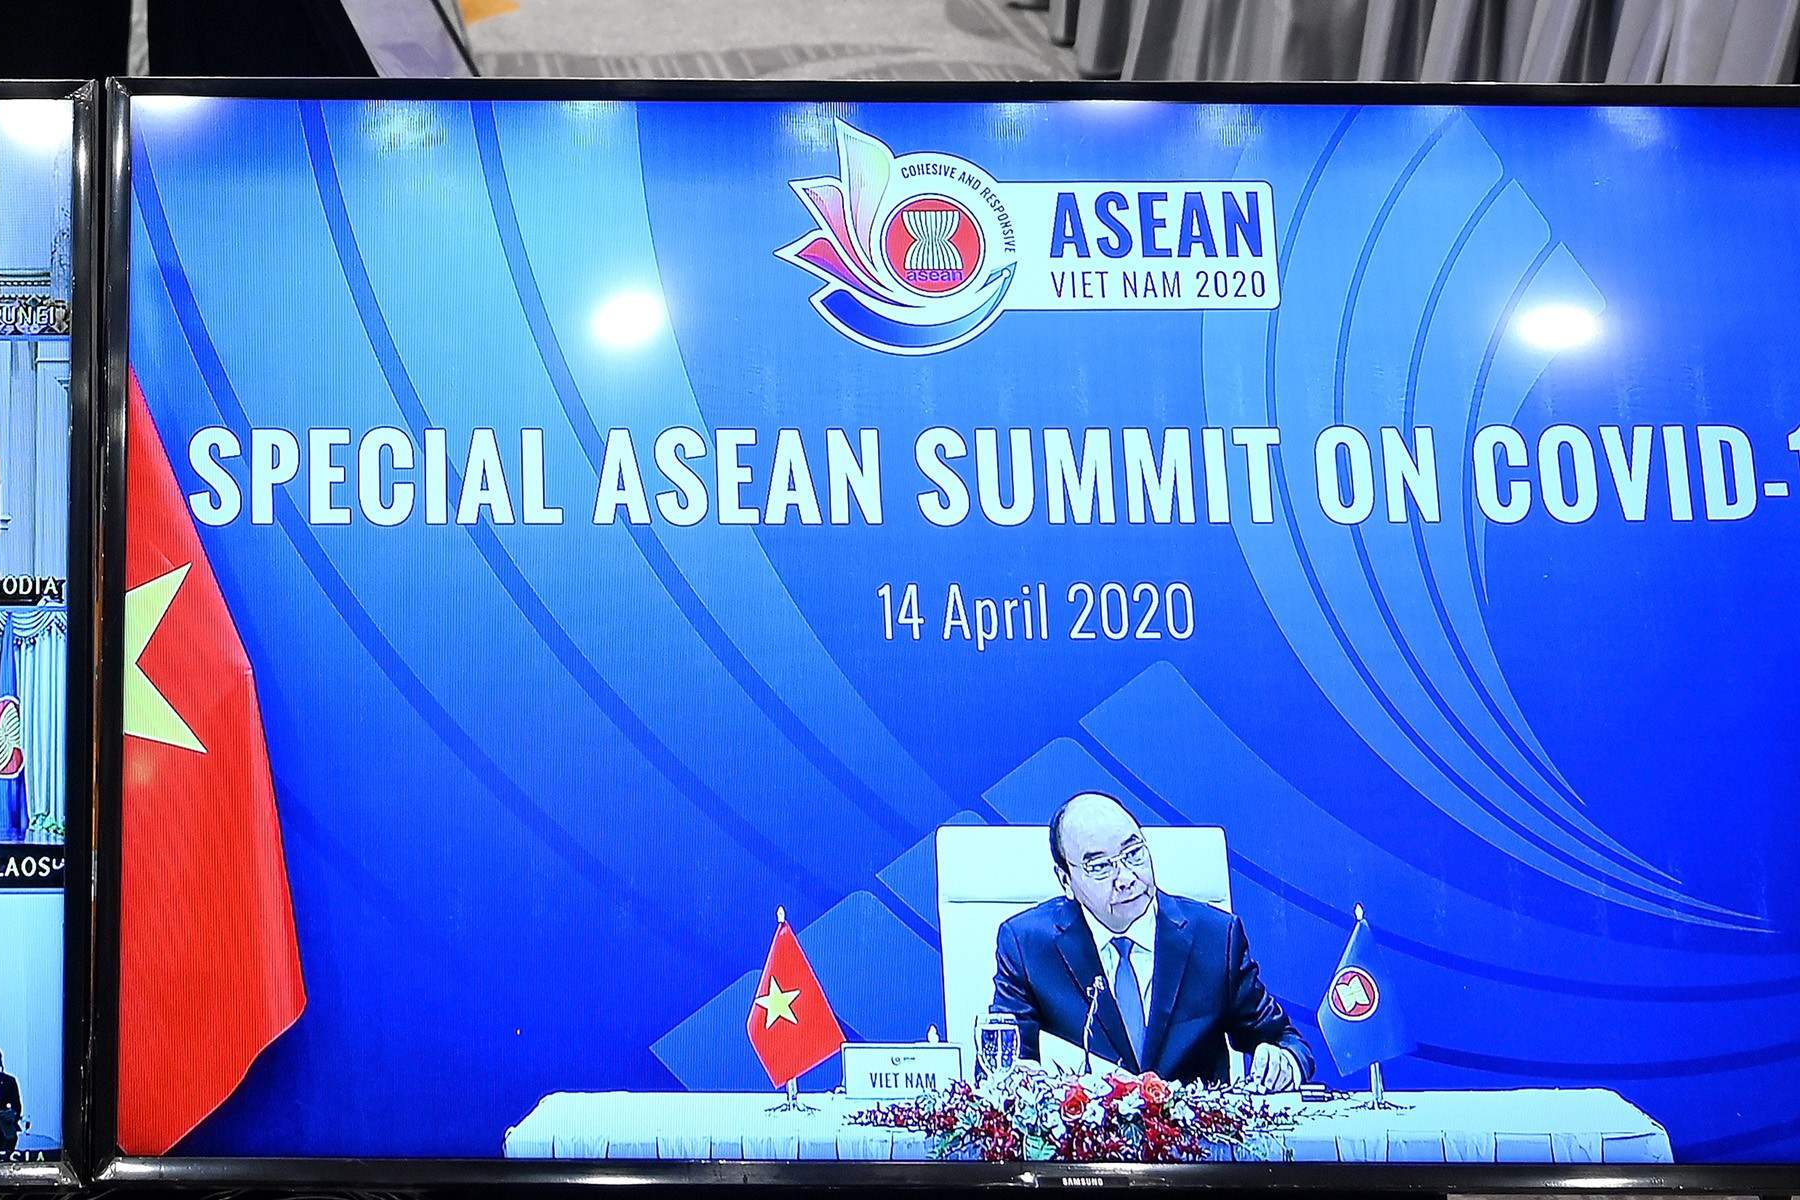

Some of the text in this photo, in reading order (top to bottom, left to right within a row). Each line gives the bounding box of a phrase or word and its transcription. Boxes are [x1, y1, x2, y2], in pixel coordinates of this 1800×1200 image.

[901, 163, 1016, 253] COHESIVE AND RESPONSIVE
[1049, 189, 1265, 259] ASEAN
[906, 270, 964, 281] asean
[1050, 270, 1267, 299] VIET NAM 2020
[188, 426, 564, 527] SPECIAL
[591, 426, 883, 527] ASEAN
[914, 425, 1282, 527] SUMMIT
[1313, 425, 1443, 526] ON
[876, 582, 1195, 652] 14 April 2020
[869, 1072, 937, 1089] VIET NAM
[1062, 1177, 1104, 1187] SAMSUNG
